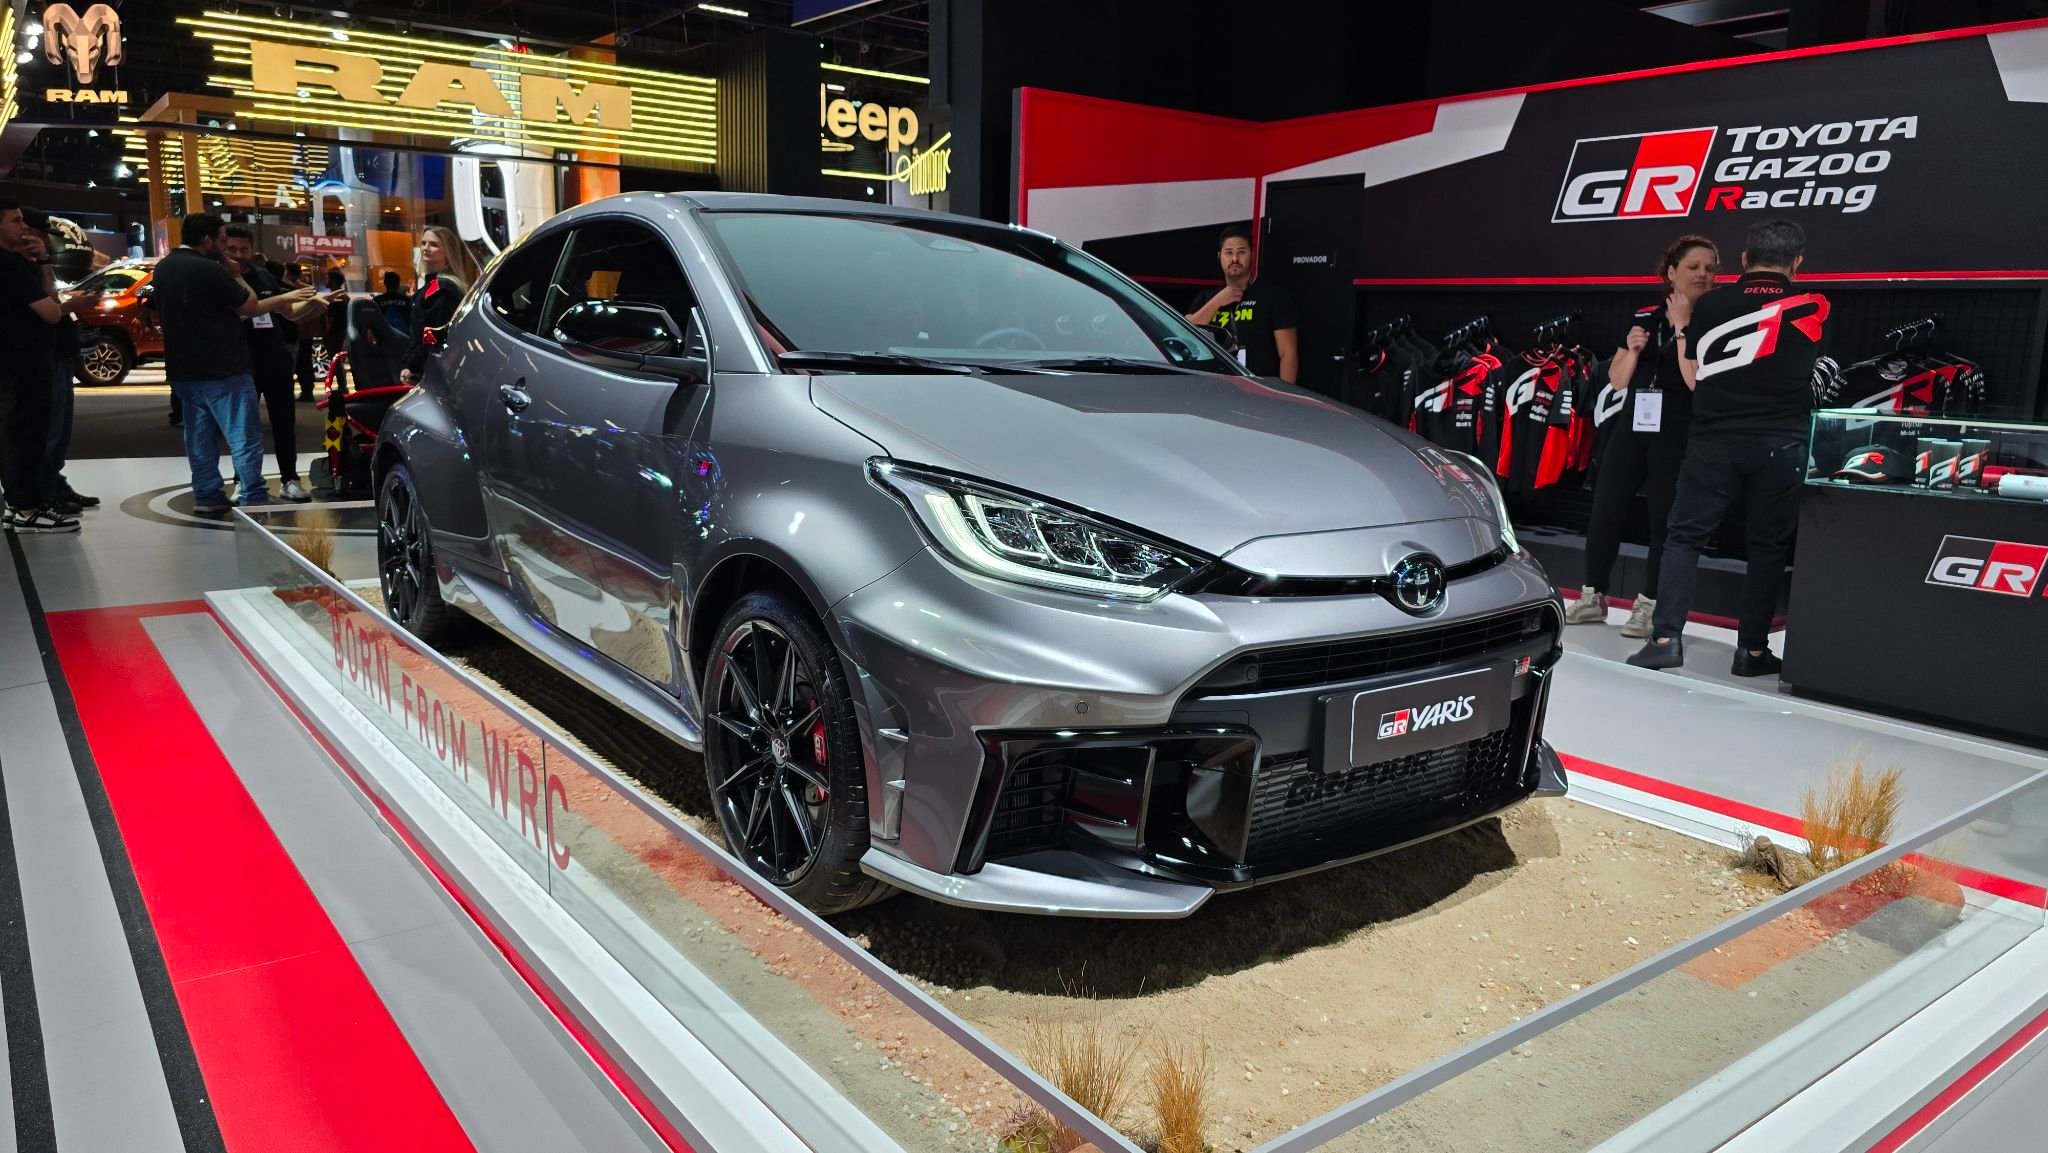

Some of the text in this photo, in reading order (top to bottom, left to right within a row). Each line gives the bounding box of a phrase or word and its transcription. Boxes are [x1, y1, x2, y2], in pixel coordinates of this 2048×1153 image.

[46, 88, 128, 103] RAM
[251, 40, 633, 131] RAM
[1726, 116, 1918, 152] TOYOTA
[1714, 150, 1892, 184] GAZOO
[1561, 165, 1696, 217] GR
[1704, 181, 1878, 213] Racing
[299, 236, 352, 248] RAM
[1293, 256, 1328, 264] PROVADOR
[1744, 287, 1784, 295] DENSO
[1695, 293, 1831, 381] GR
[1933, 556, 2036, 593] GR
[331, 607, 571, 870] BORN FROM WRC
